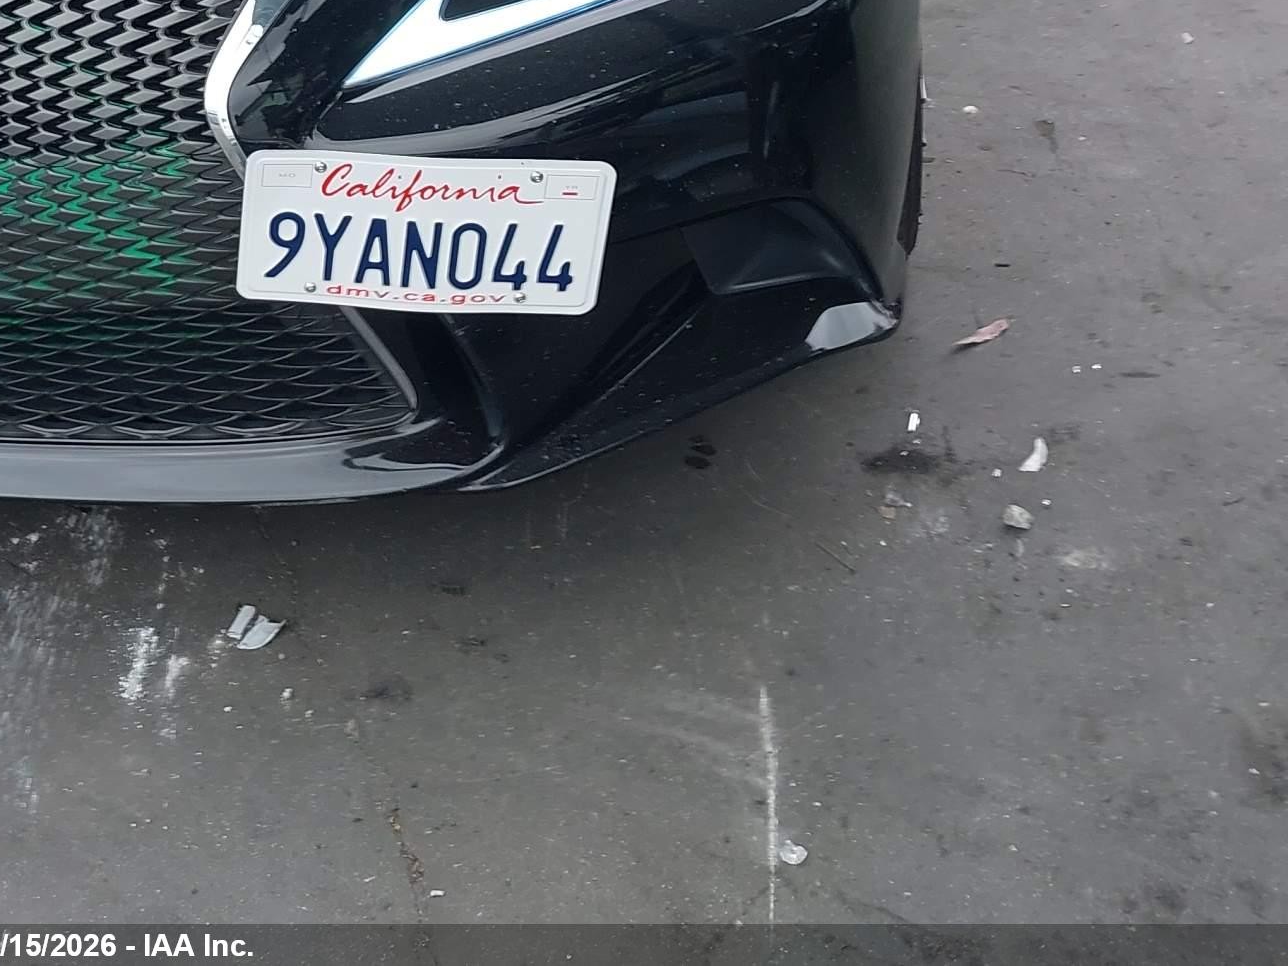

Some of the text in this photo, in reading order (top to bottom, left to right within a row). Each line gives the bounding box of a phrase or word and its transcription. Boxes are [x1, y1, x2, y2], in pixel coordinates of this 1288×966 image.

[320, 163, 545, 212] California
[264, 211, 574, 291] 9YAN044
[326, 284, 506, 305] dmv.ca.gov
